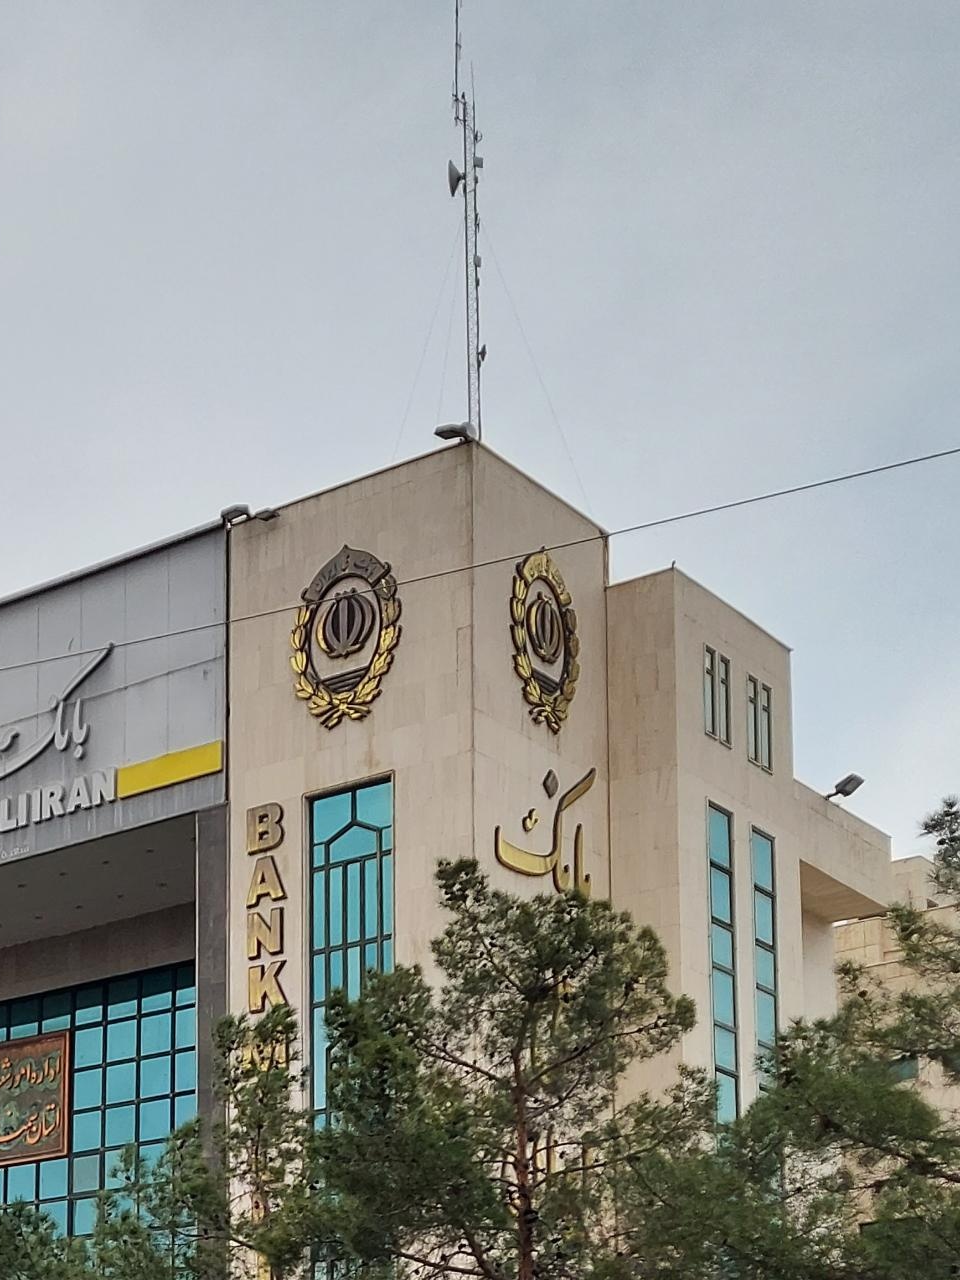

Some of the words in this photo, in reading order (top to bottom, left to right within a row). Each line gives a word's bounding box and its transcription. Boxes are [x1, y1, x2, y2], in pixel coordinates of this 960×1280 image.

[30, 767, 118, 825] IRAN
[245, 801, 290, 1014] BANK
[7, 1062, 31, 1090] امور
[29, 1055, 61, 1085] اداره
[25, 1103, 61, 1145] استان
